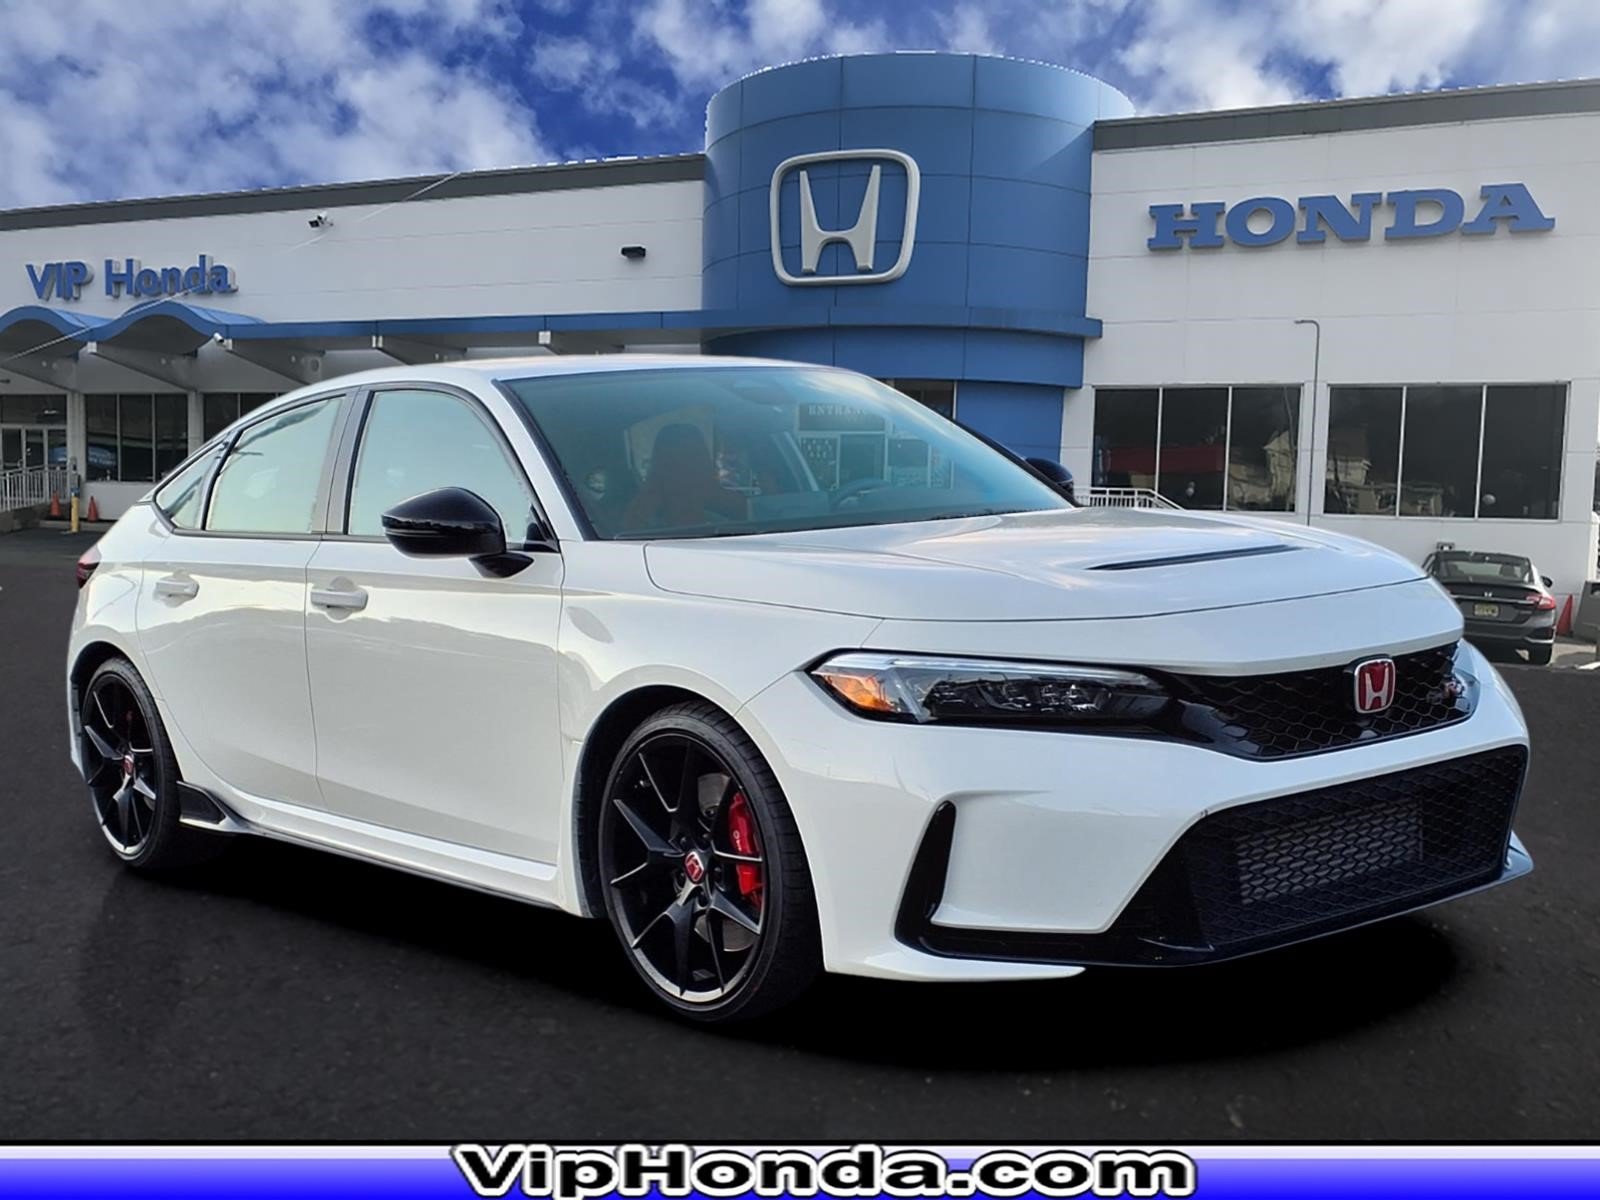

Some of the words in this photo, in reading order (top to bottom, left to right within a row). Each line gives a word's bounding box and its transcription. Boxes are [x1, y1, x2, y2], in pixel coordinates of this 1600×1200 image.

[1147, 183, 1556, 251] HONDA
[25, 260, 93, 300] VIP
[104, 254, 238, 298] Honda
